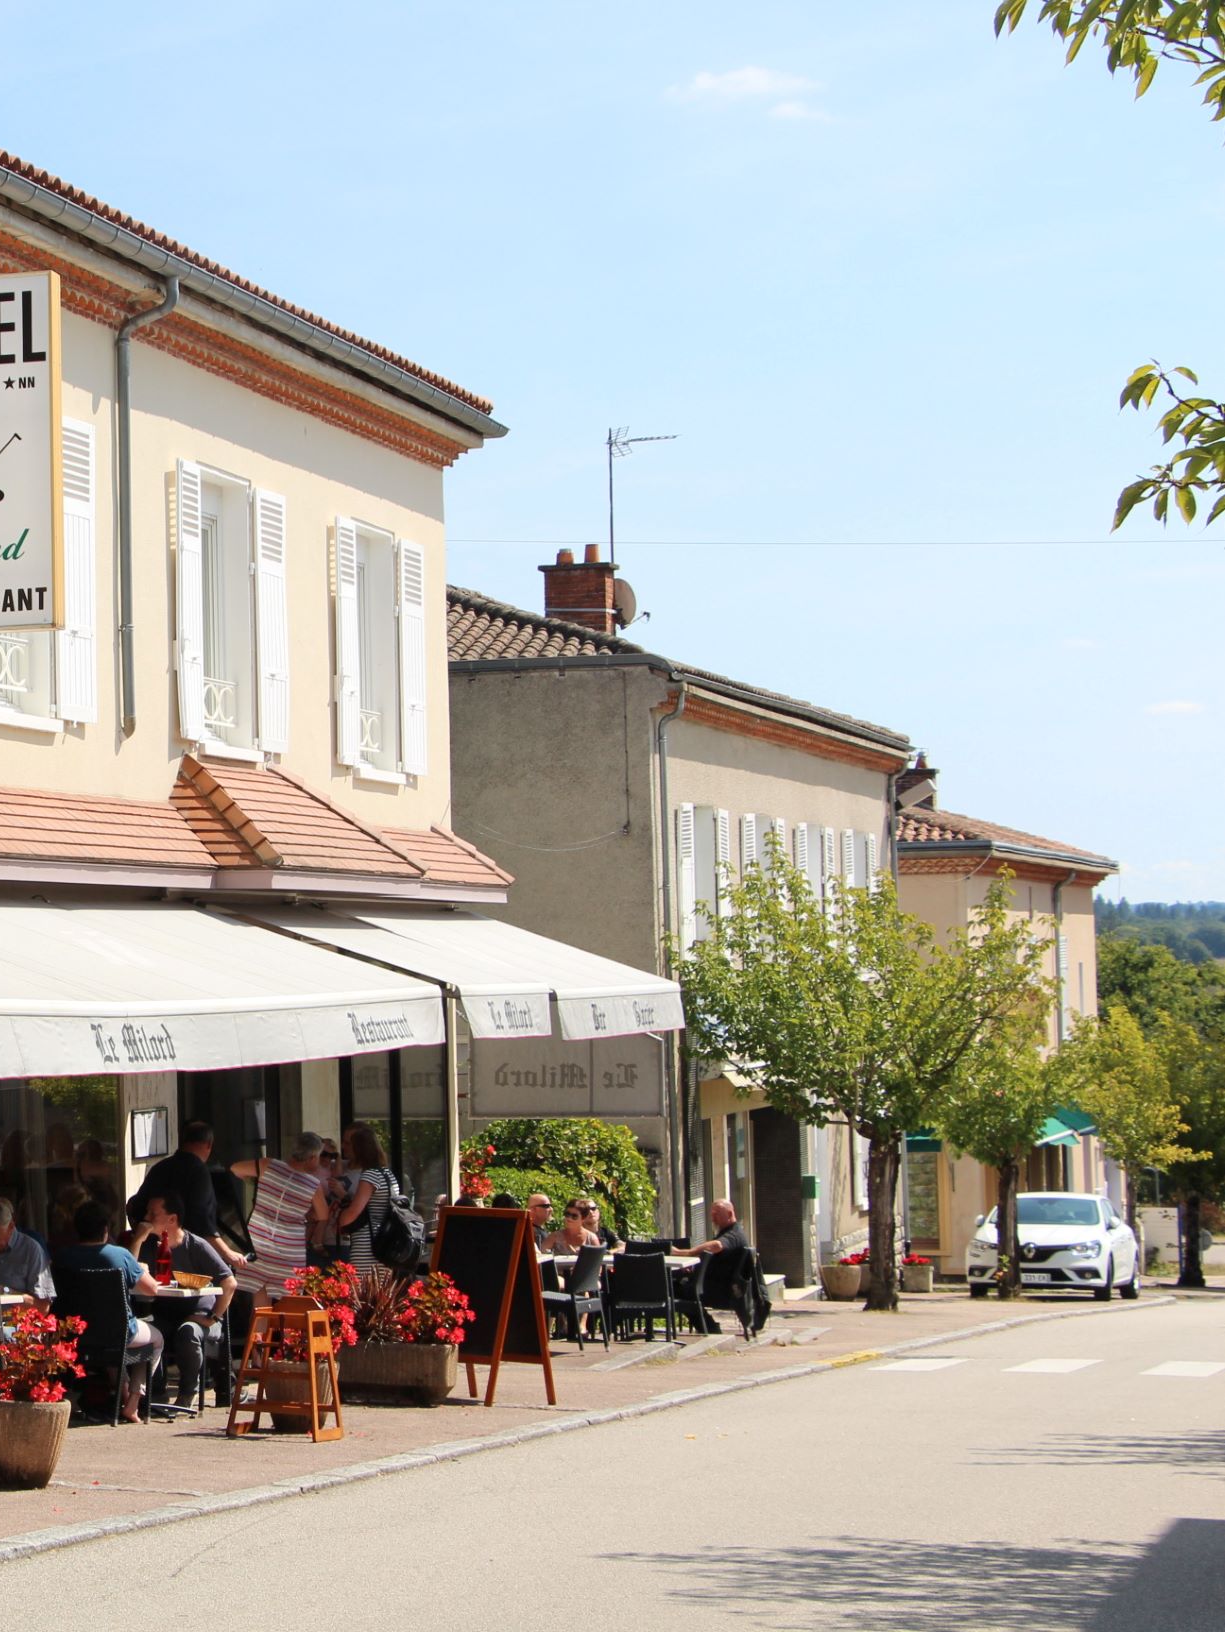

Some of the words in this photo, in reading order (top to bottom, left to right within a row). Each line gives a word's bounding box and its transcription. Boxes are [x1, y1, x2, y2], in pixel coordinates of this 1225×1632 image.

[18, 376, 36, 389] NN
[91, 1023, 120, 1064] Le
[121, 1022, 177, 1065] Milord
[347, 1011, 414, 1045] Restaurant
